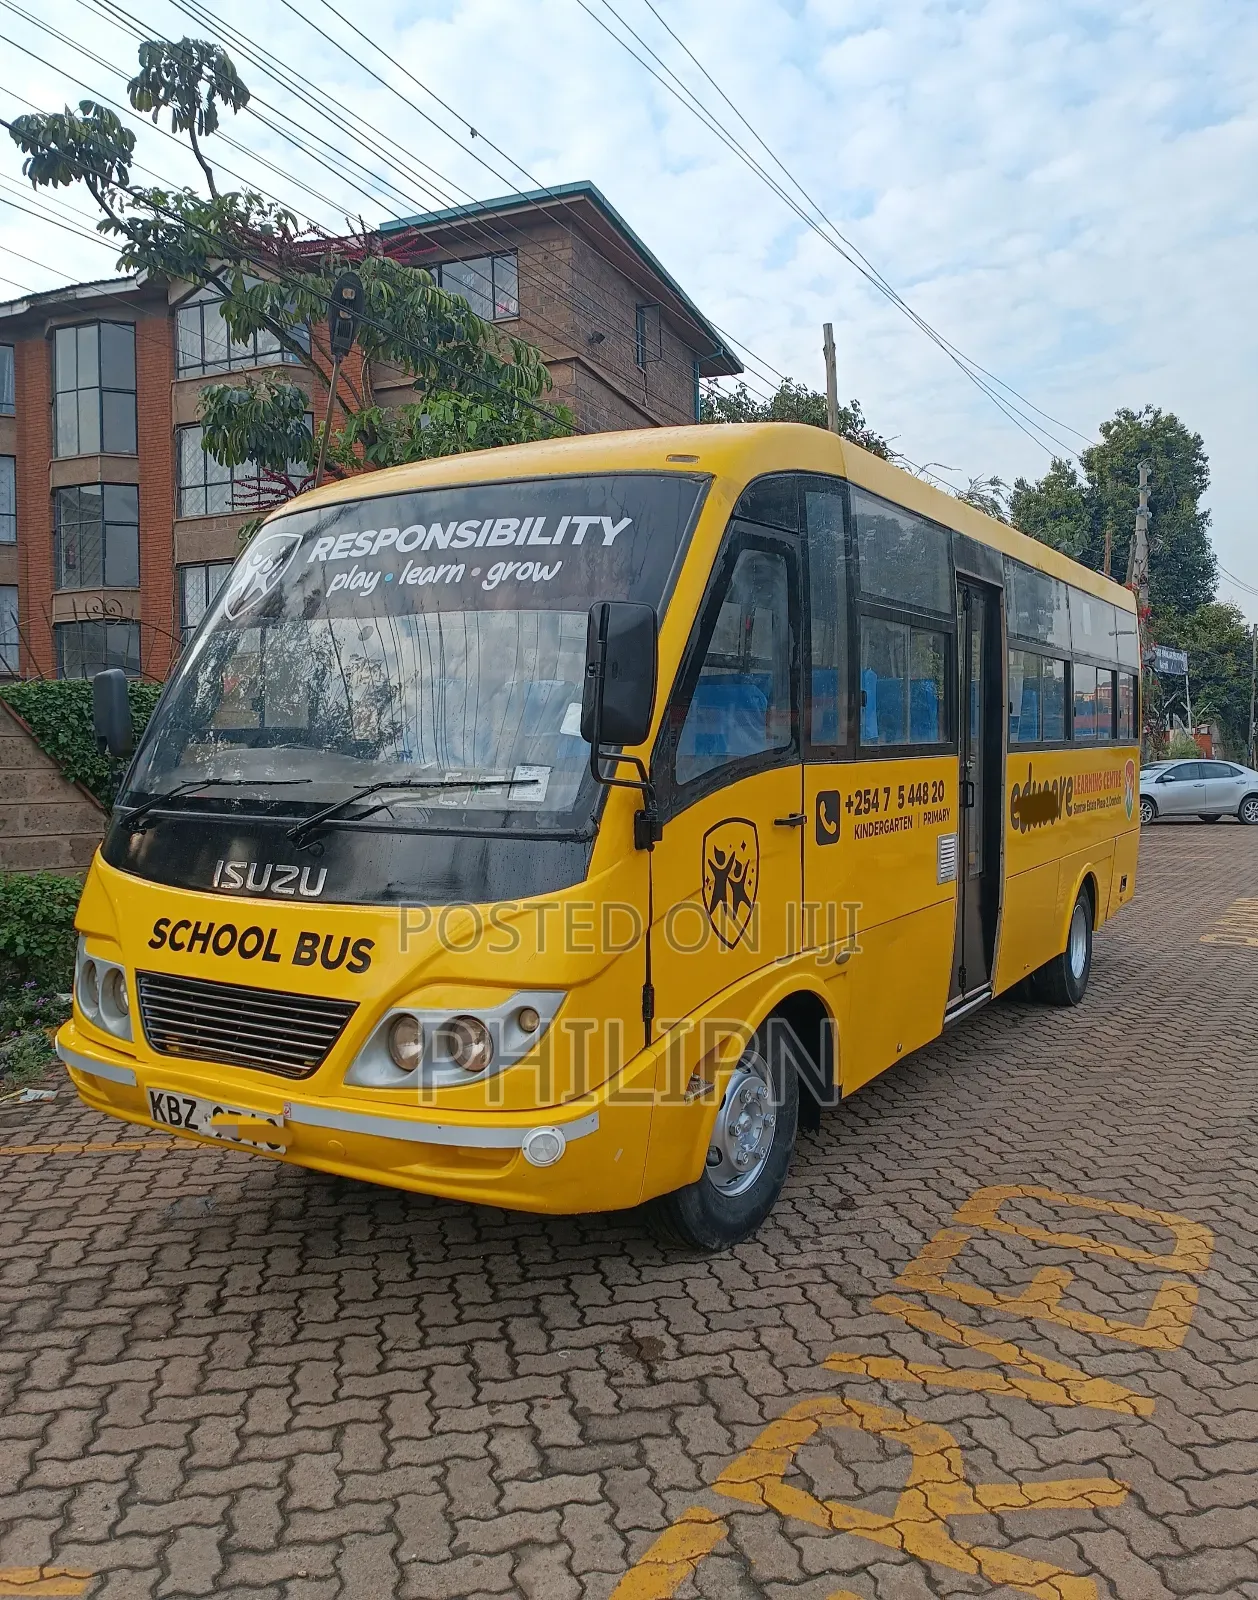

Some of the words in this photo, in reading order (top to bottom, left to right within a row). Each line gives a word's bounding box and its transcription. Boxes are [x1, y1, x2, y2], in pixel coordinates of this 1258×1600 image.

[307, 515, 632, 563] RESPONSIBILITY
[326, 565, 380, 598] play
[398, 561, 463, 586] learn
[481, 560, 562, 591] grow
[845, 788, 879, 815] +254
[1074, 772, 1102, 795] LEARNING
[854, 815, 913, 840] KINDERGARTEN
[923, 808, 950, 826] PRIMARY
[212, 860, 327, 897] ISUZU
[148, 917, 282, 963] SCHOOL
[292, 931, 376, 974] BUS
[150, 1091, 199, 1130] KBZ
